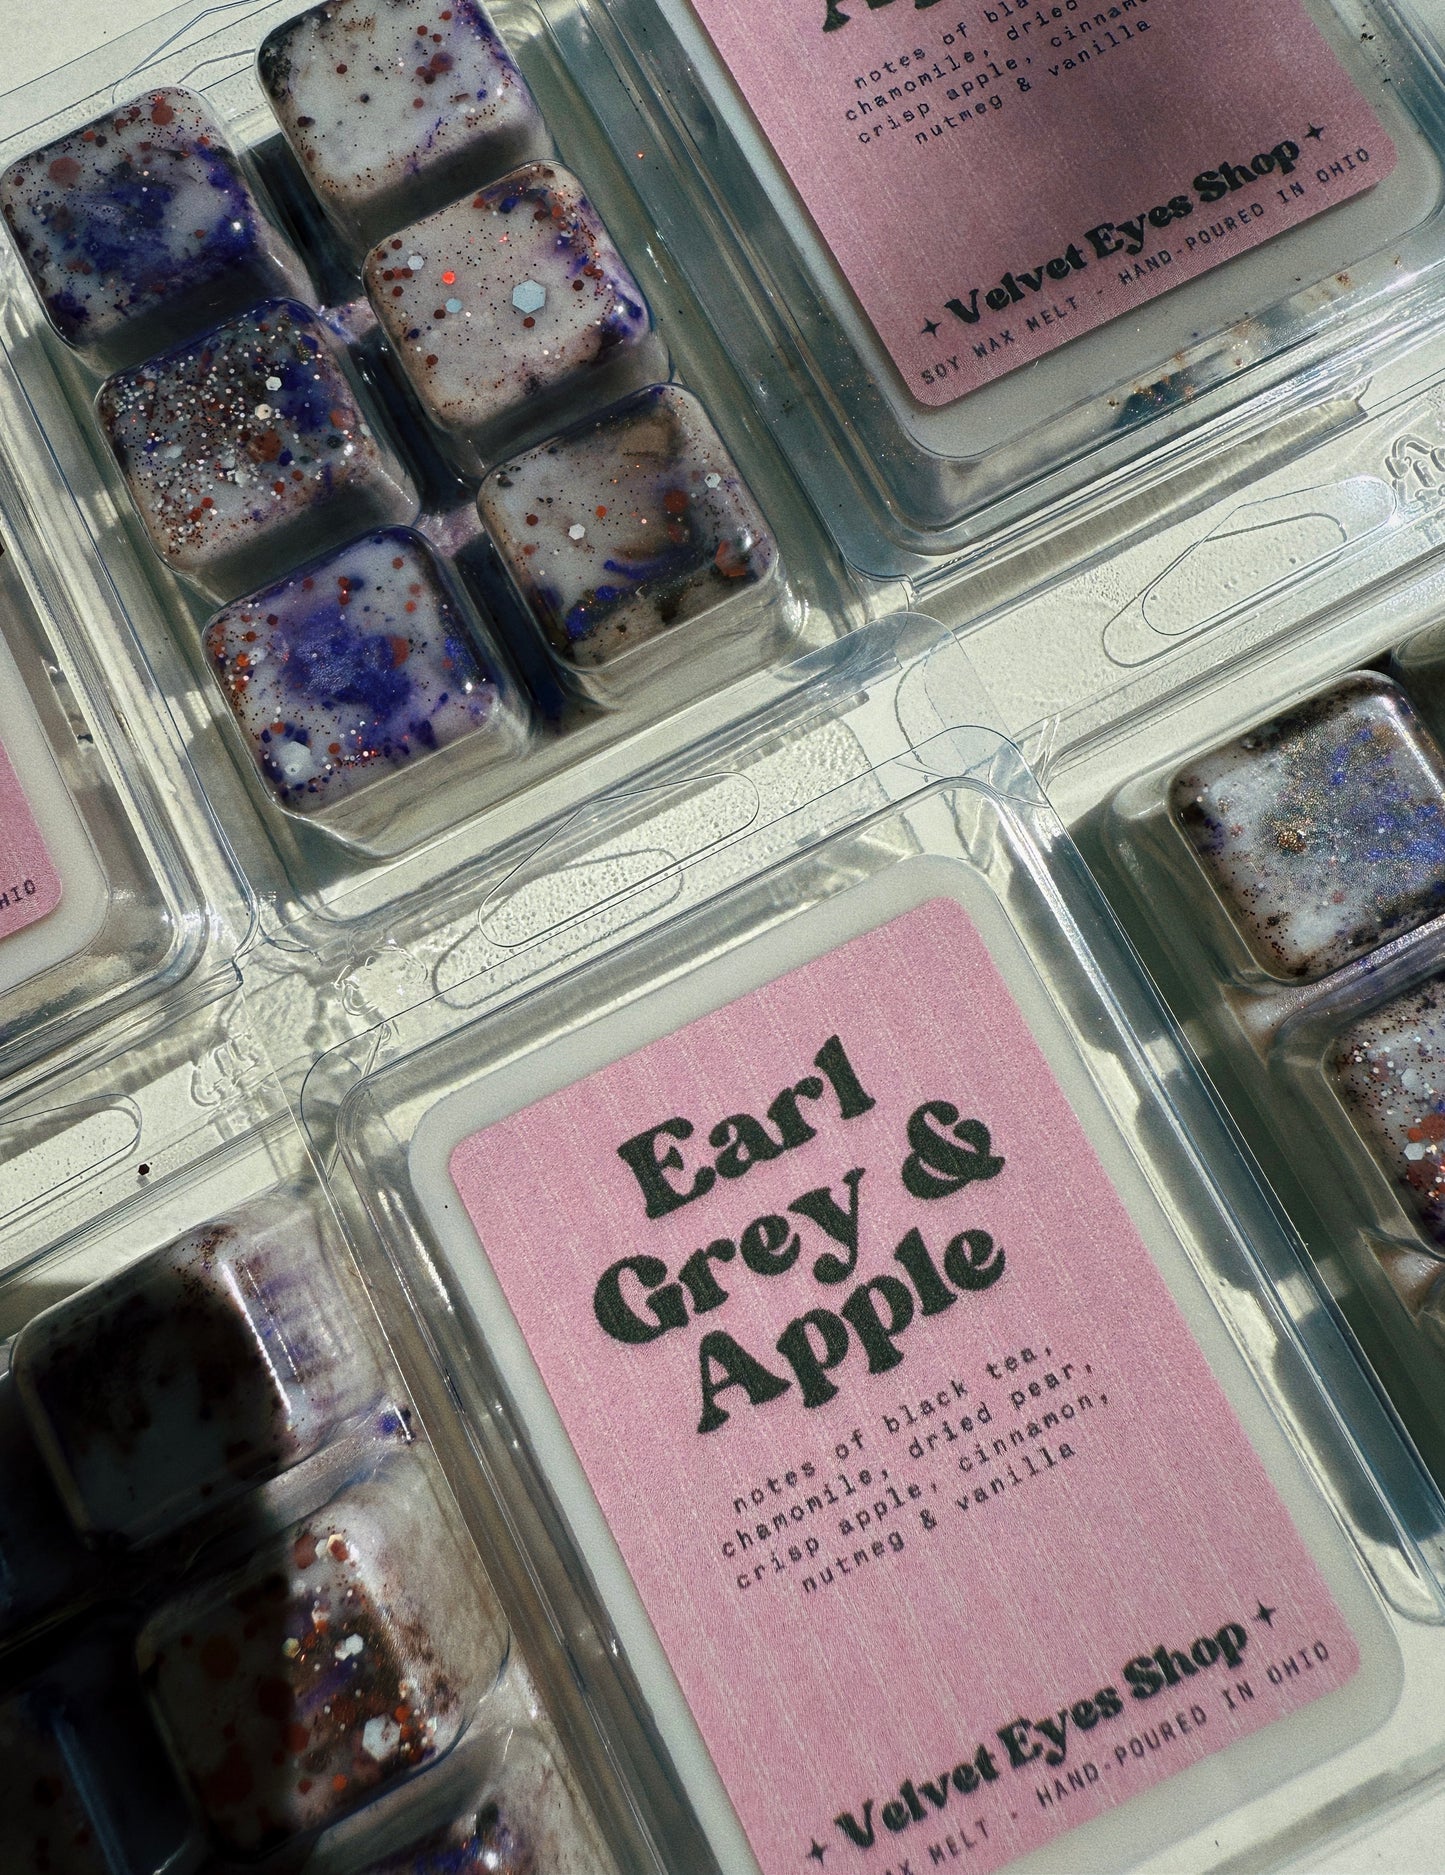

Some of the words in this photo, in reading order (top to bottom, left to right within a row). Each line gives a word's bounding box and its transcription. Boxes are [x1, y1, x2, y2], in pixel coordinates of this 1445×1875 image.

[846, 48, 990, 121] chamomile,
[855, 47, 925, 90] notes
[943, 22, 968, 46] of
[859, 102, 931, 145] crisp
[946, 56, 1032, 101] apple,
[1050, 0, 1148, 48] cinnam
[915, 94, 1003, 145] nutmeg
[1016, 76, 1032, 92] &
[1048, 19, 1151, 78] vanilla
[920, 356, 960, 385] SOY
[972, 330, 1015, 358] WAX
[1026, 296, 1078, 333] MELT
[1119, 203, 1264, 285] HAND-POURED
[1277, 182, 1305, 203] IN
[1316, 148, 1370, 183] OHIO
[944, 243, 1087, 324] Velvet
[1084, 195, 1194, 256] Eyes
[1193, 140, 1300, 202] Shop
[617, 1034, 876, 1220] Earl
[593, 1167, 866, 1345] Grey
[901, 1100, 1006, 1200] &
[698, 1226, 1006, 1435] Apple
[721, 1467, 889, 1558] chamomile,
[909, 1401, 991, 1459] dried
[1012, 1362, 1093, 1410] pear,
[733, 1459, 816, 1515] notes
[835, 1428, 865, 1461] of
[882, 1379, 969, 1434] black
[986, 1345, 1052, 1380] tea,
[736, 1536, 820, 1590] crisp
[838, 1481, 938, 1536] apple,
[958, 1391, 1109, 1473] cinnamon,
[802, 1529, 905, 1593] nutmeg
[920, 1508, 938, 1532] &
[956, 1441, 1077, 1512] vanilla
[833, 1742, 1000, 1849] Velvet
[997, 1685, 1124, 1767] Eyes
[1123, 1622, 1247, 1701] Shop
[927, 1817, 989, 1866] MELT
[1036, 1704, 1208, 1808] HAND-POURED
[1222, 1680, 1255, 1711] IN
[1266, 1639, 1330, 1686] OHIO
